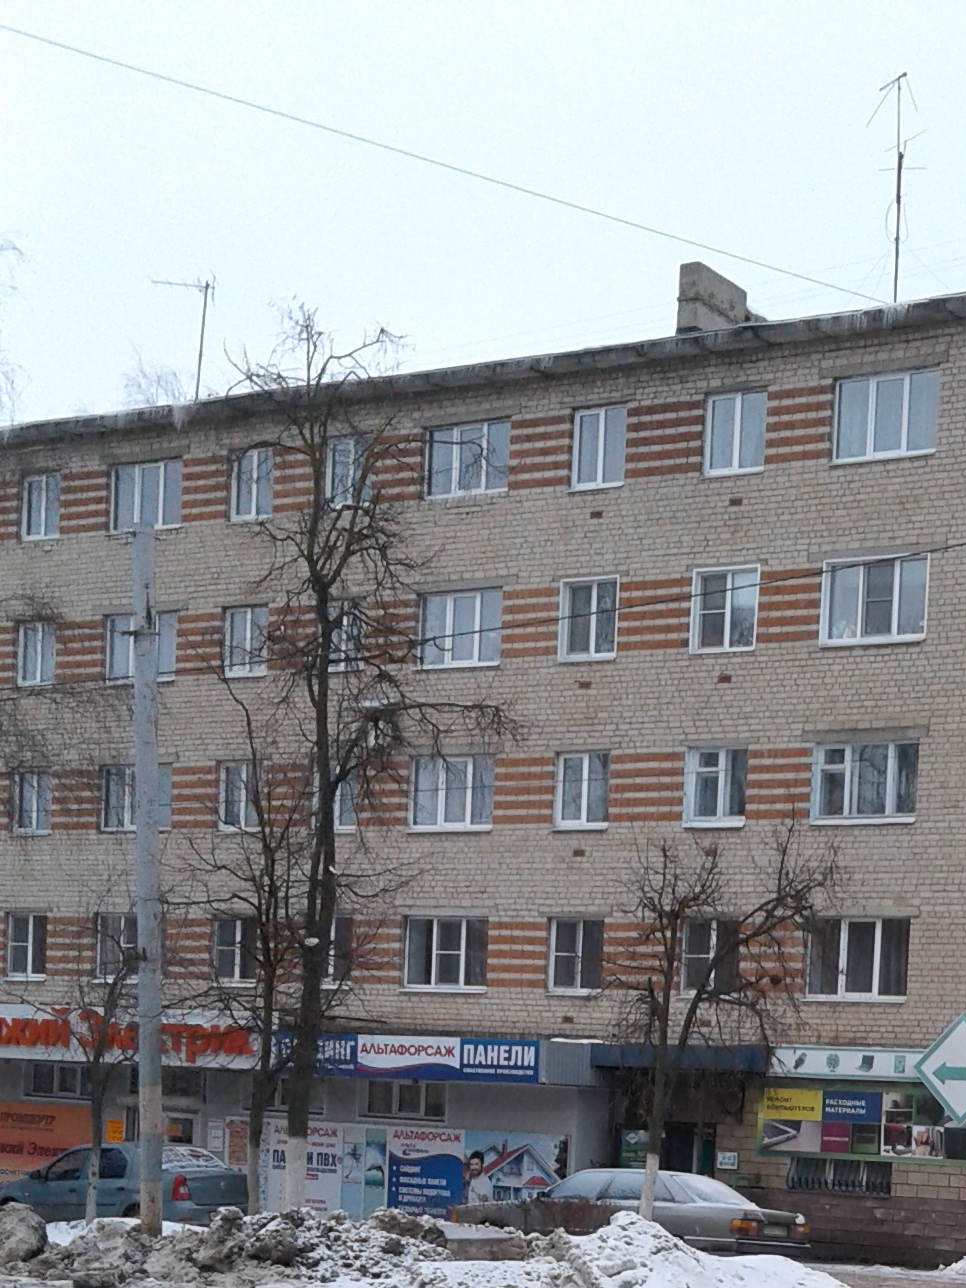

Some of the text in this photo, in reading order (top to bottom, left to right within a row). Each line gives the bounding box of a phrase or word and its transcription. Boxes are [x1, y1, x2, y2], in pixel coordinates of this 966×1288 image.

[78, 1009, 254, 1064] Элетрик
[281, 1038, 355, 1061] СИНГ
[360, 1042, 456, 1058] АЛЬТАФОРСАЖ
[463, 1044, 536, 1067] ПАНЕЛИ
[826, 1098, 866, 1106] РАСХОДНЫЕ
[826, 1107, 866, 1115] МАТЕРИАЛЫ
[274, 1125, 338, 1138] АЛОРСАЖ
[393, 1130, 461, 1143] АЛЬТАФОРСАЖ
[316, 1152, 338, 1168] ПВХ
